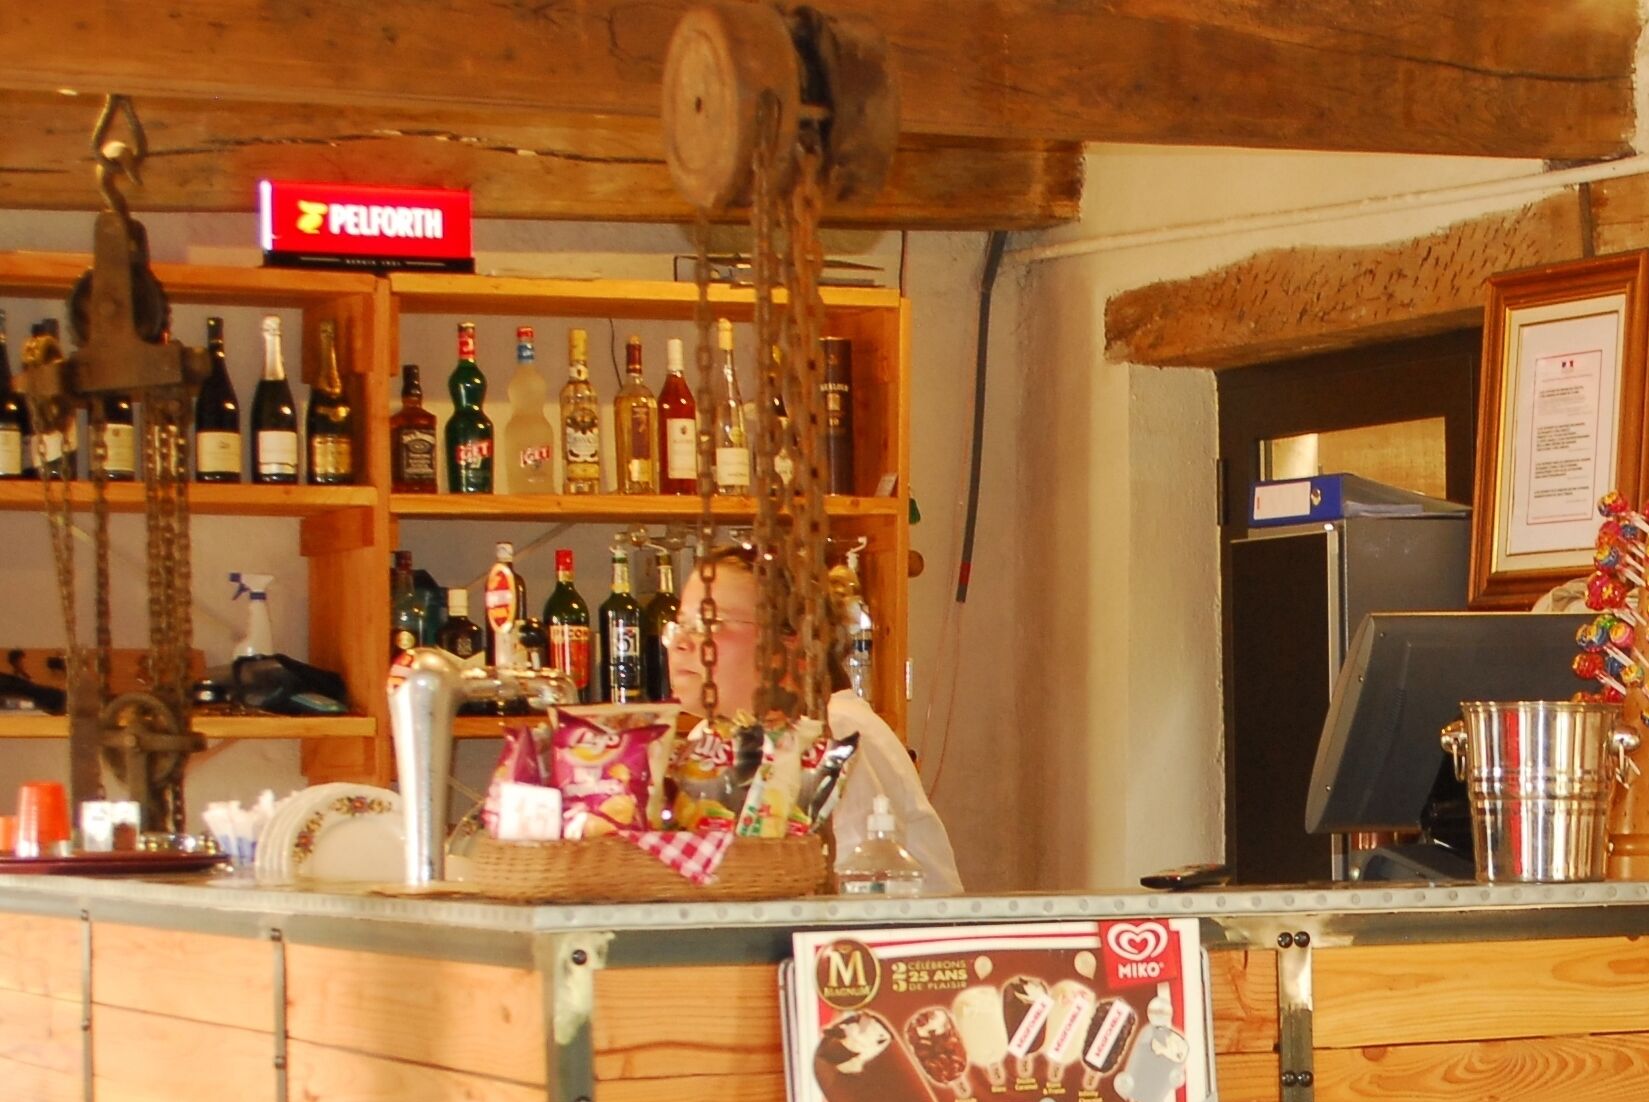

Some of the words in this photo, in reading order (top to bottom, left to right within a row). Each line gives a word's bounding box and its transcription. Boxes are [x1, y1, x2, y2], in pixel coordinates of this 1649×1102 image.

[328, 203, 443, 239] PELFORTH
[908, 970, 929, 983] 25
[933, 969, 968, 982] ANS
[1117, 960, 1161, 979] MIKO
[927, 980, 968, 991] PLAISIR
